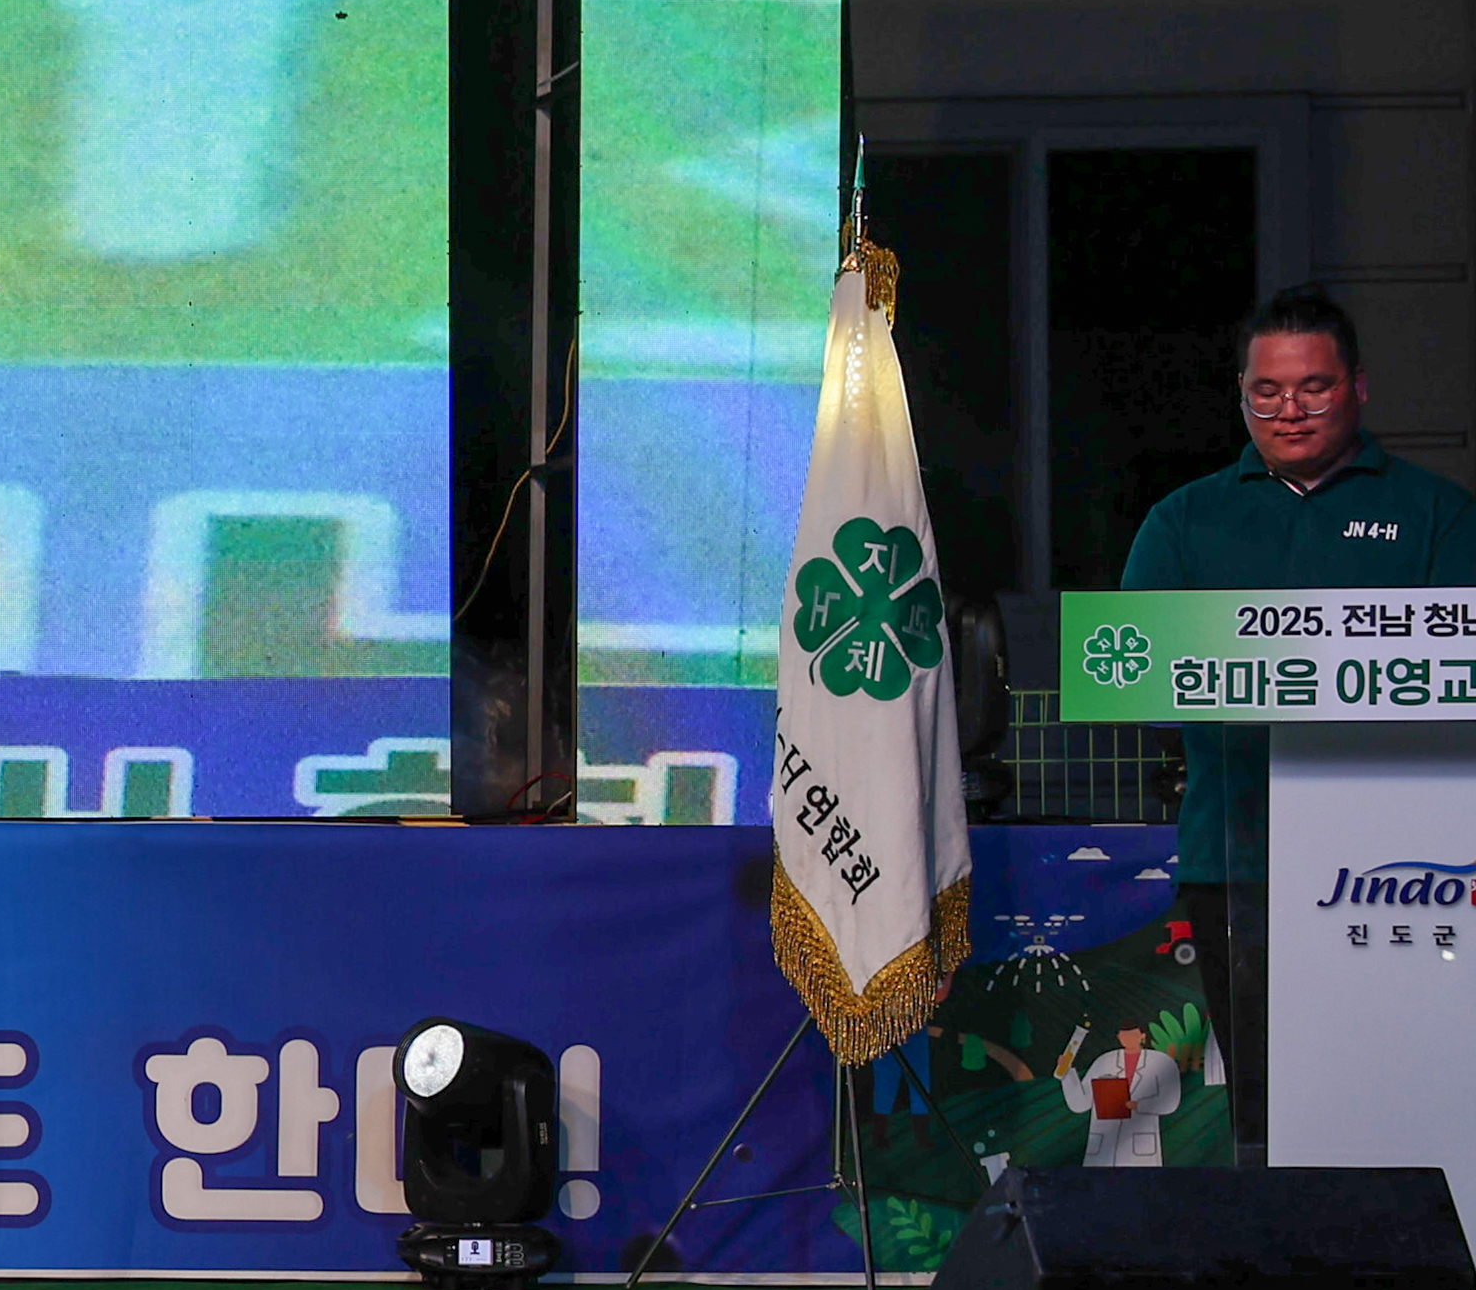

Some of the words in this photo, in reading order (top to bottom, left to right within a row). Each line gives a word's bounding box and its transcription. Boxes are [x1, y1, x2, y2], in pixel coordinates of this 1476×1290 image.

[1343, 521, 1366, 538] JN
[1367, 522, 1398, 540] 4-H
[1237, 606, 1332, 638] 2025.
[1342, 604, 1416, 638] 전남
[843, 639, 887, 683] 체
[1173, 659, 1319, 707] 한마음
[1316, 867, 1466, 908] Jindo
